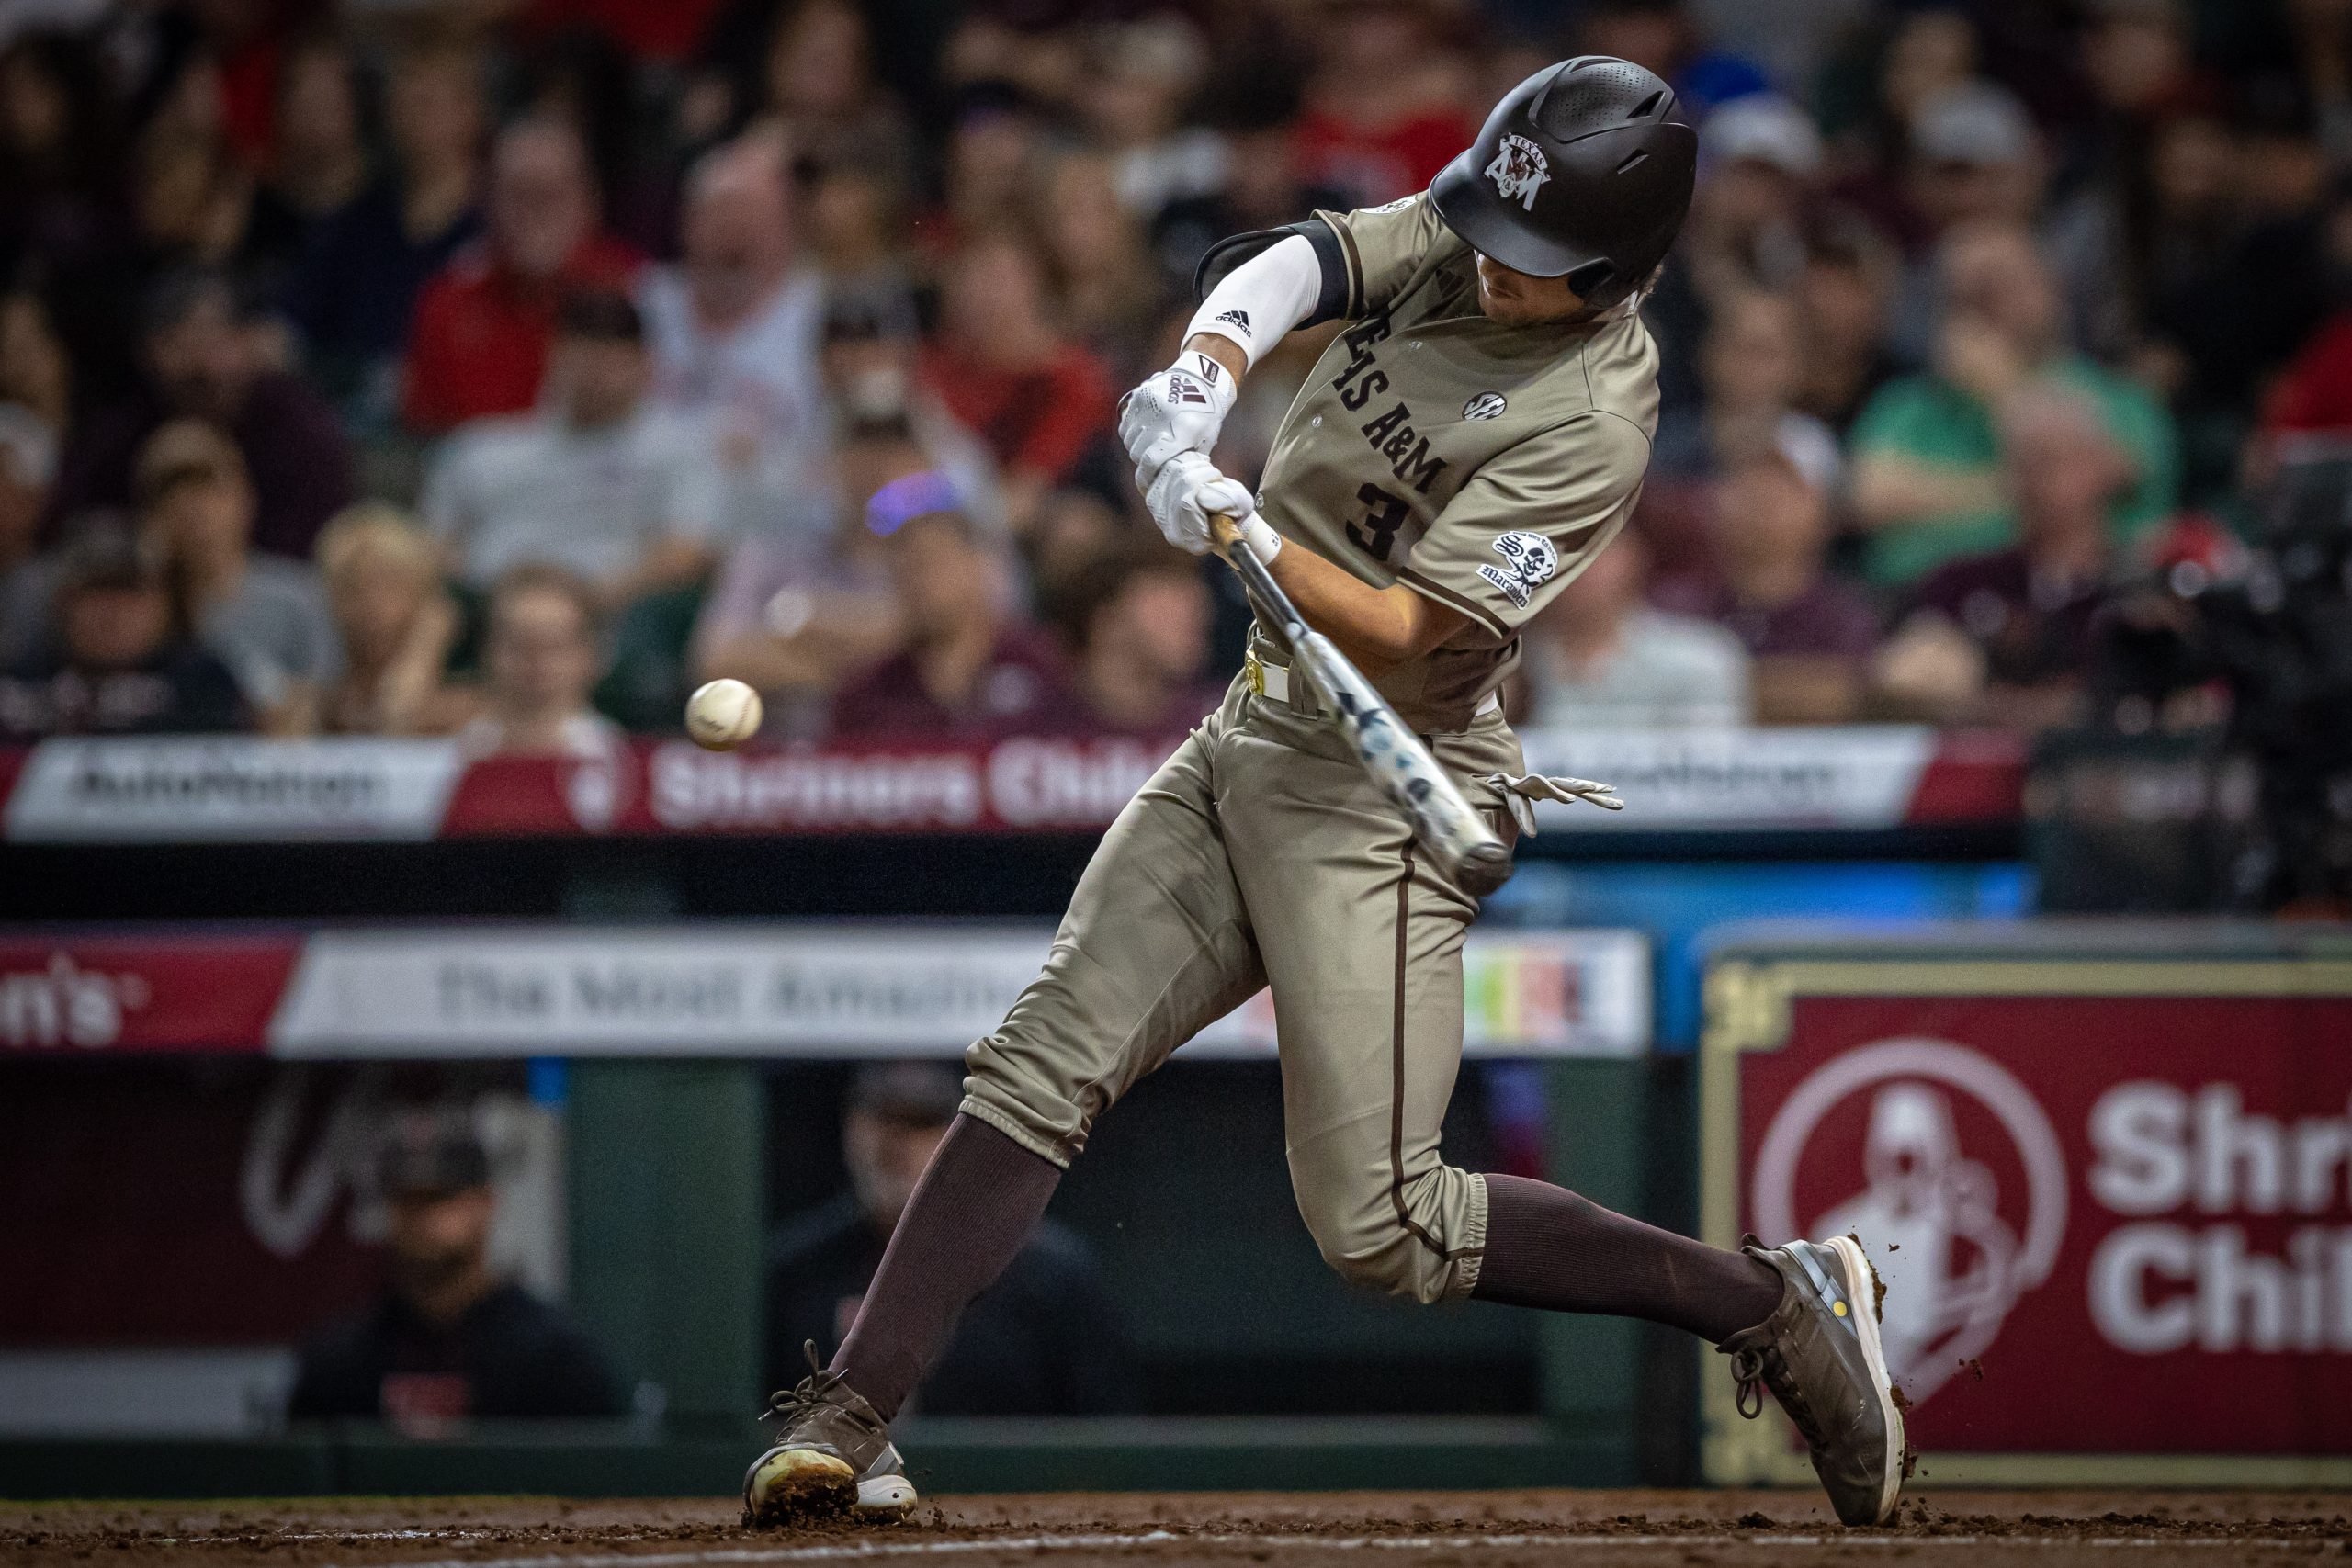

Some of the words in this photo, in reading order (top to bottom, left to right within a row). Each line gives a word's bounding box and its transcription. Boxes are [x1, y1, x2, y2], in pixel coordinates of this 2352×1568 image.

[1514, 136, 1545, 166] TEXAS
[1216, 315, 1252, 338] adidas
[1168, 375, 1182, 404] adidas
[1361, 401, 1448, 494] A&M
[1345, 482, 1410, 561] 3
[649, 738, 981, 825] Shriners
[2086, 1081, 2352, 1213] Shr
